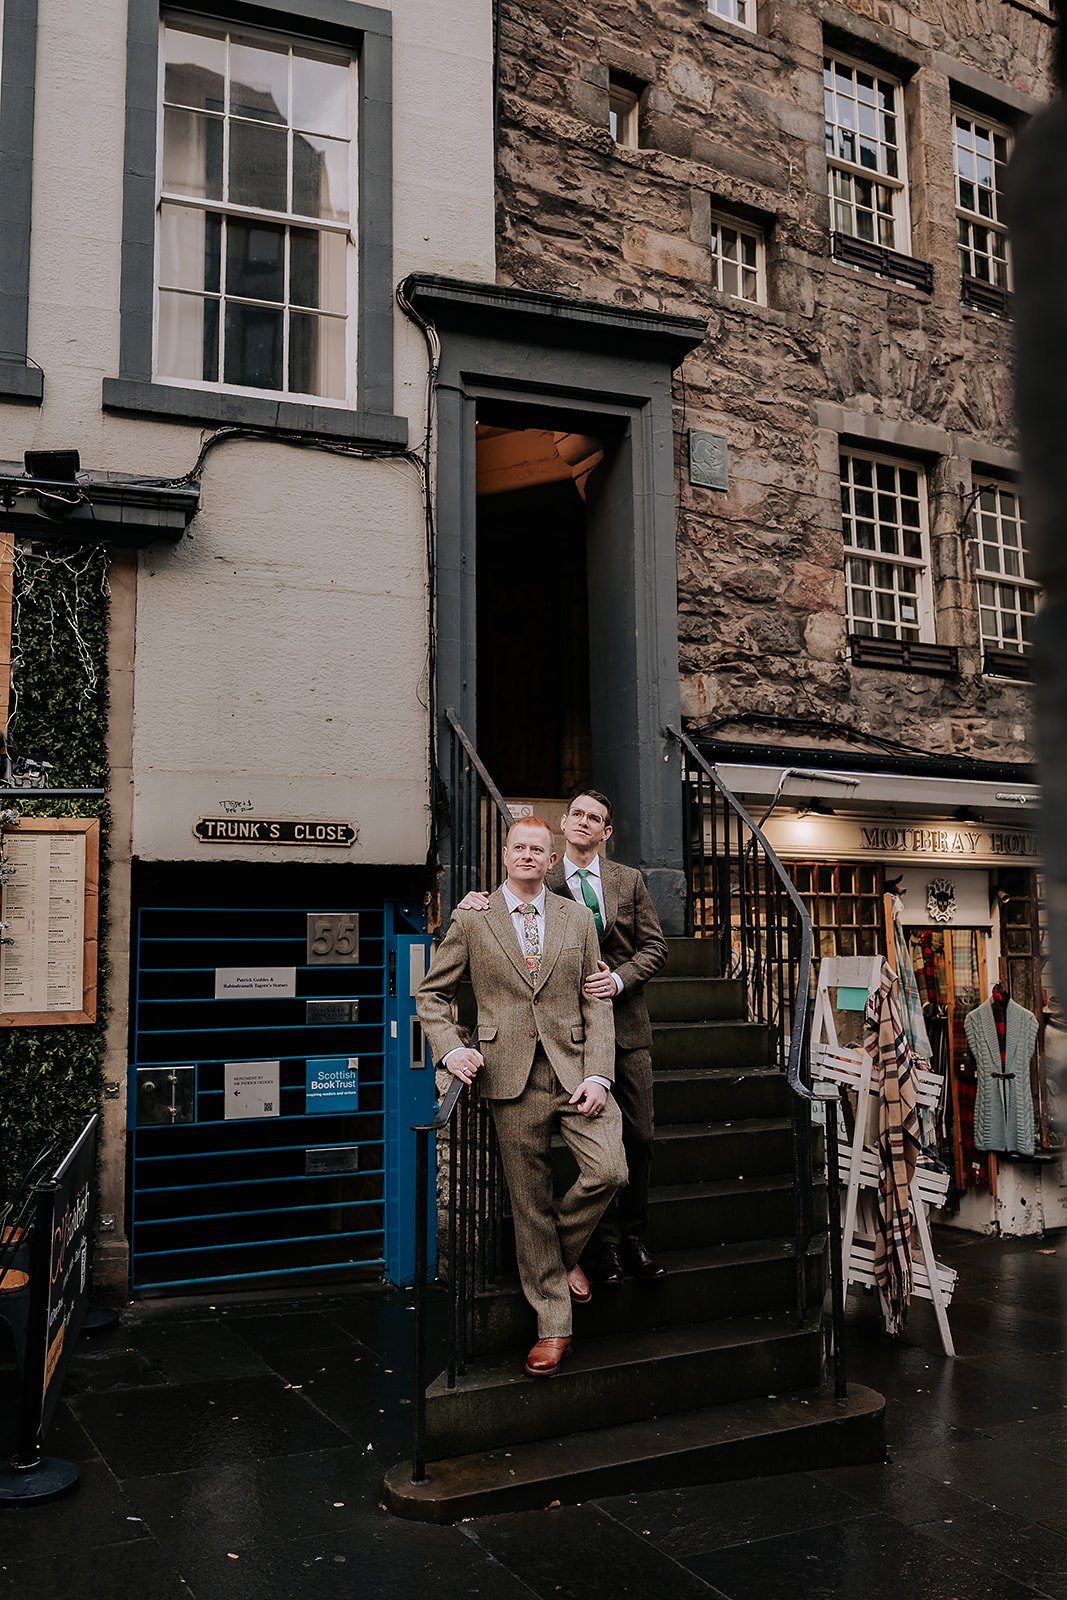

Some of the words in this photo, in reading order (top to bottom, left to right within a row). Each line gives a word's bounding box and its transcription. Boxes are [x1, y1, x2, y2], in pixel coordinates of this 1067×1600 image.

[205, 821, 280, 838] TRUNK'S
[294, 825, 346, 840] CLOSE
[860, 826, 981, 853] MOUBRAY
[989, 832, 1040, 856] HOU
[312, 922, 356, 956] 55
[310, 1080, 356, 1090] BookTrust
[317, 1070, 356, 1081] Scottish
